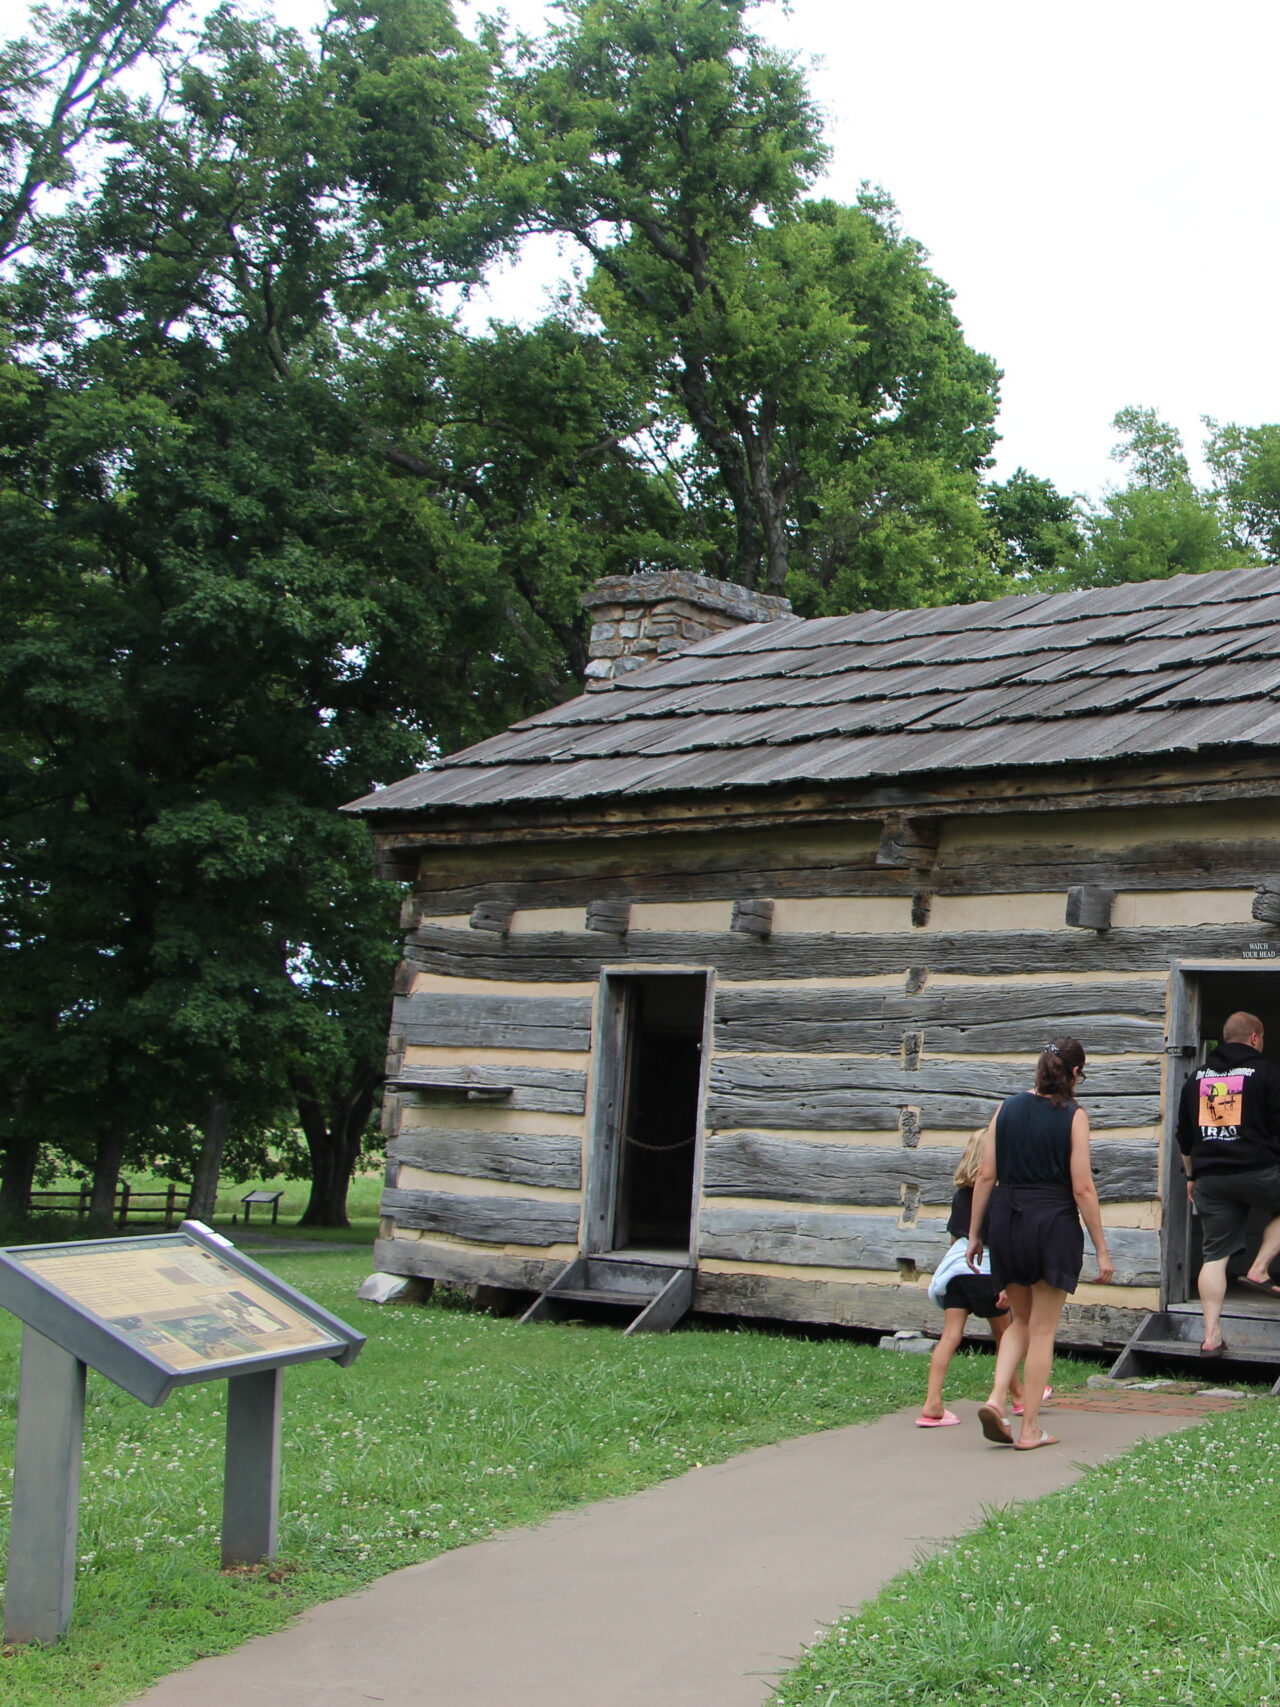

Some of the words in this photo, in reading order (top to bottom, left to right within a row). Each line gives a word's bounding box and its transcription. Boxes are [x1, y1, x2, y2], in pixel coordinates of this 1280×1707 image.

[1249, 942, 1269, 950] WATCH
[1242, 950, 1258, 958] YOUR
[1259, 950, 1276, 958] HEAD
[1227, 1067, 1256, 1077] Summer
